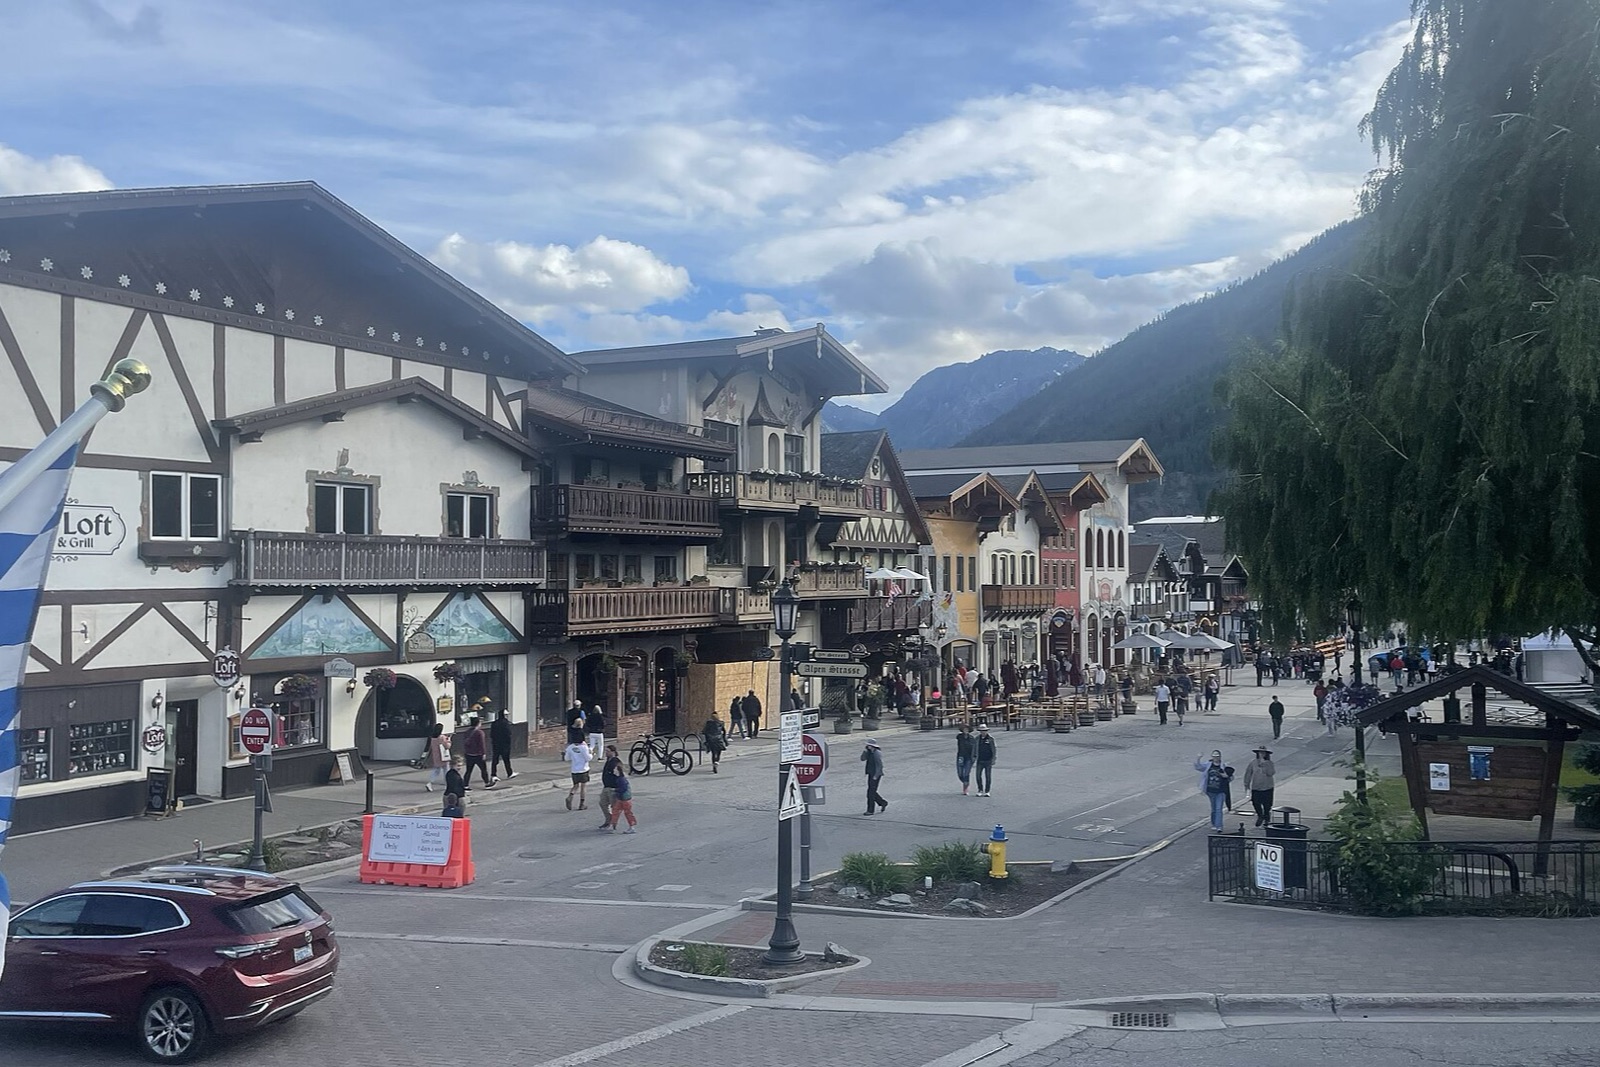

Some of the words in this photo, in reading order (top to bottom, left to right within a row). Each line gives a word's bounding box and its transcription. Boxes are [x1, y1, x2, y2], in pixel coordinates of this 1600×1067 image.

[64, 512, 112, 536] Loft
[57, 537, 67, 547] &
[69, 537, 94, 548] Grill
[215, 660, 237, 674] Loft
[804, 664, 826, 674] Alpen
[829, 666, 861, 676] Strasse
[244, 716, 253, 724] DO
[255, 717, 267, 725] NOT
[146, 732, 164, 742] Loft
[802, 744, 817, 752] NOT
[796, 767, 815, 776] NTER
[1260, 848, 1278, 862] NO
